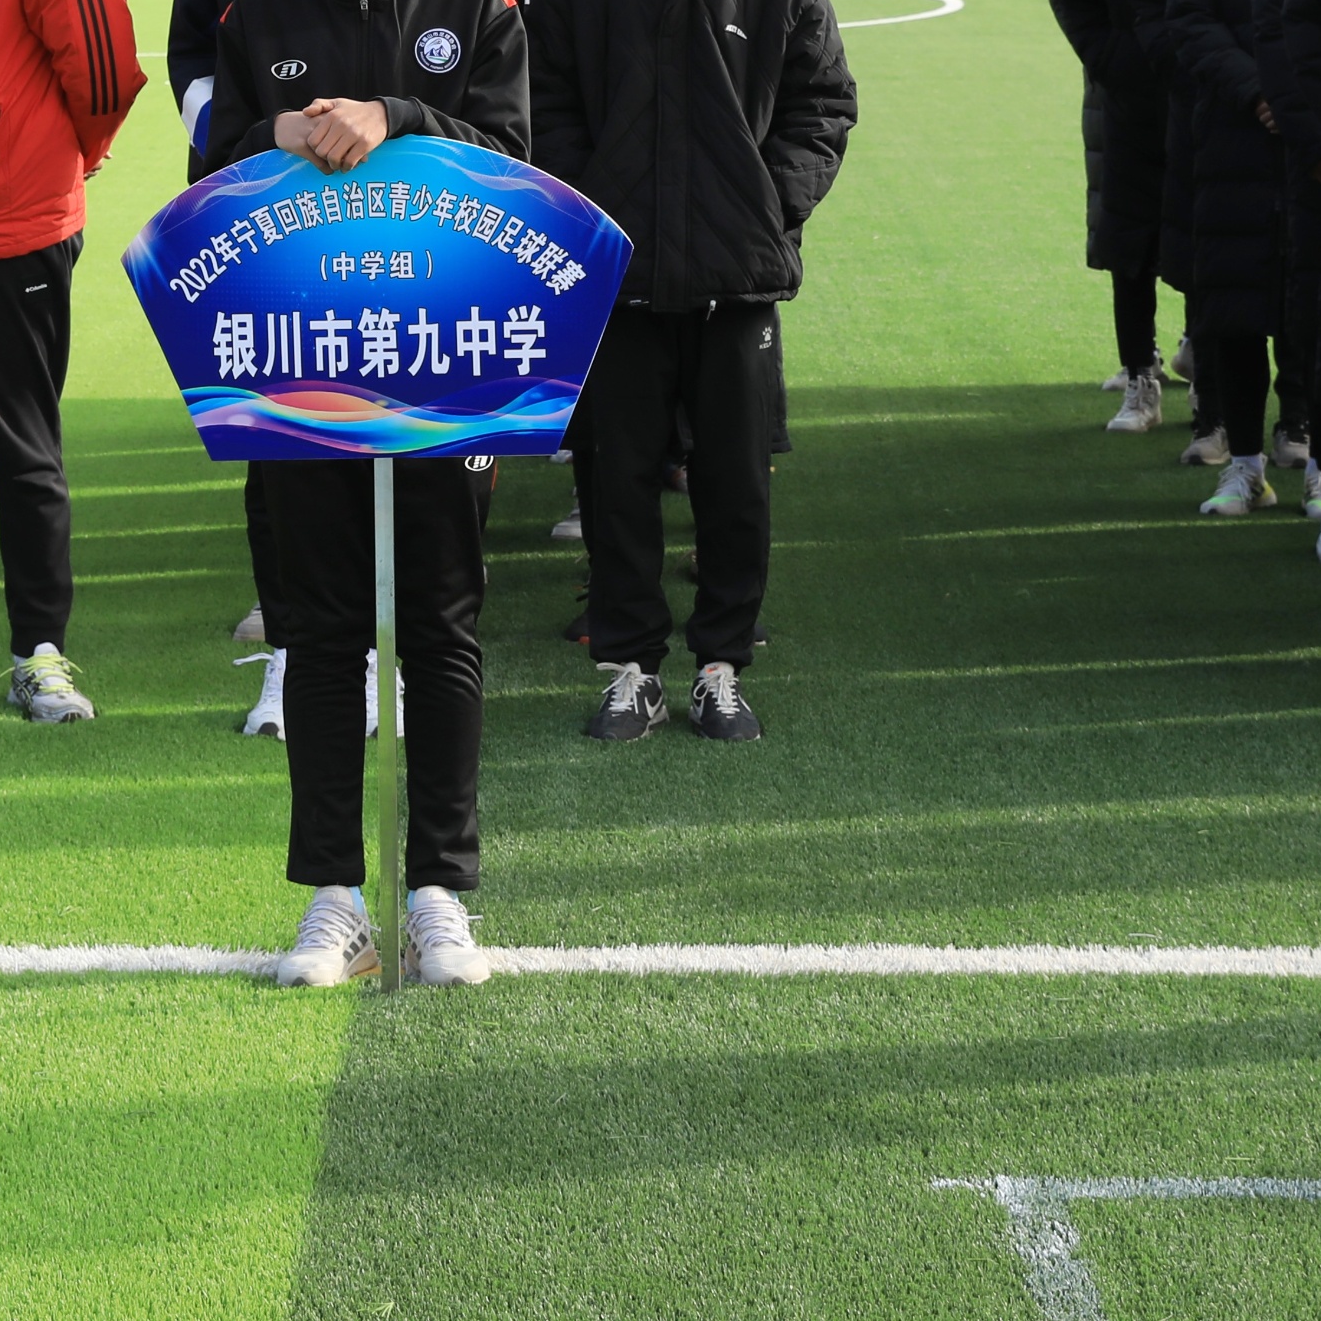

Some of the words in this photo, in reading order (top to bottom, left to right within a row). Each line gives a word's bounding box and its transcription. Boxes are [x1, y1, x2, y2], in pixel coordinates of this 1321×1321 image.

[169, 180, 587, 304] 2022年宁夏回族自治区青少年校园足球联赛
[212, 304, 547, 379] 银川市第九中学
